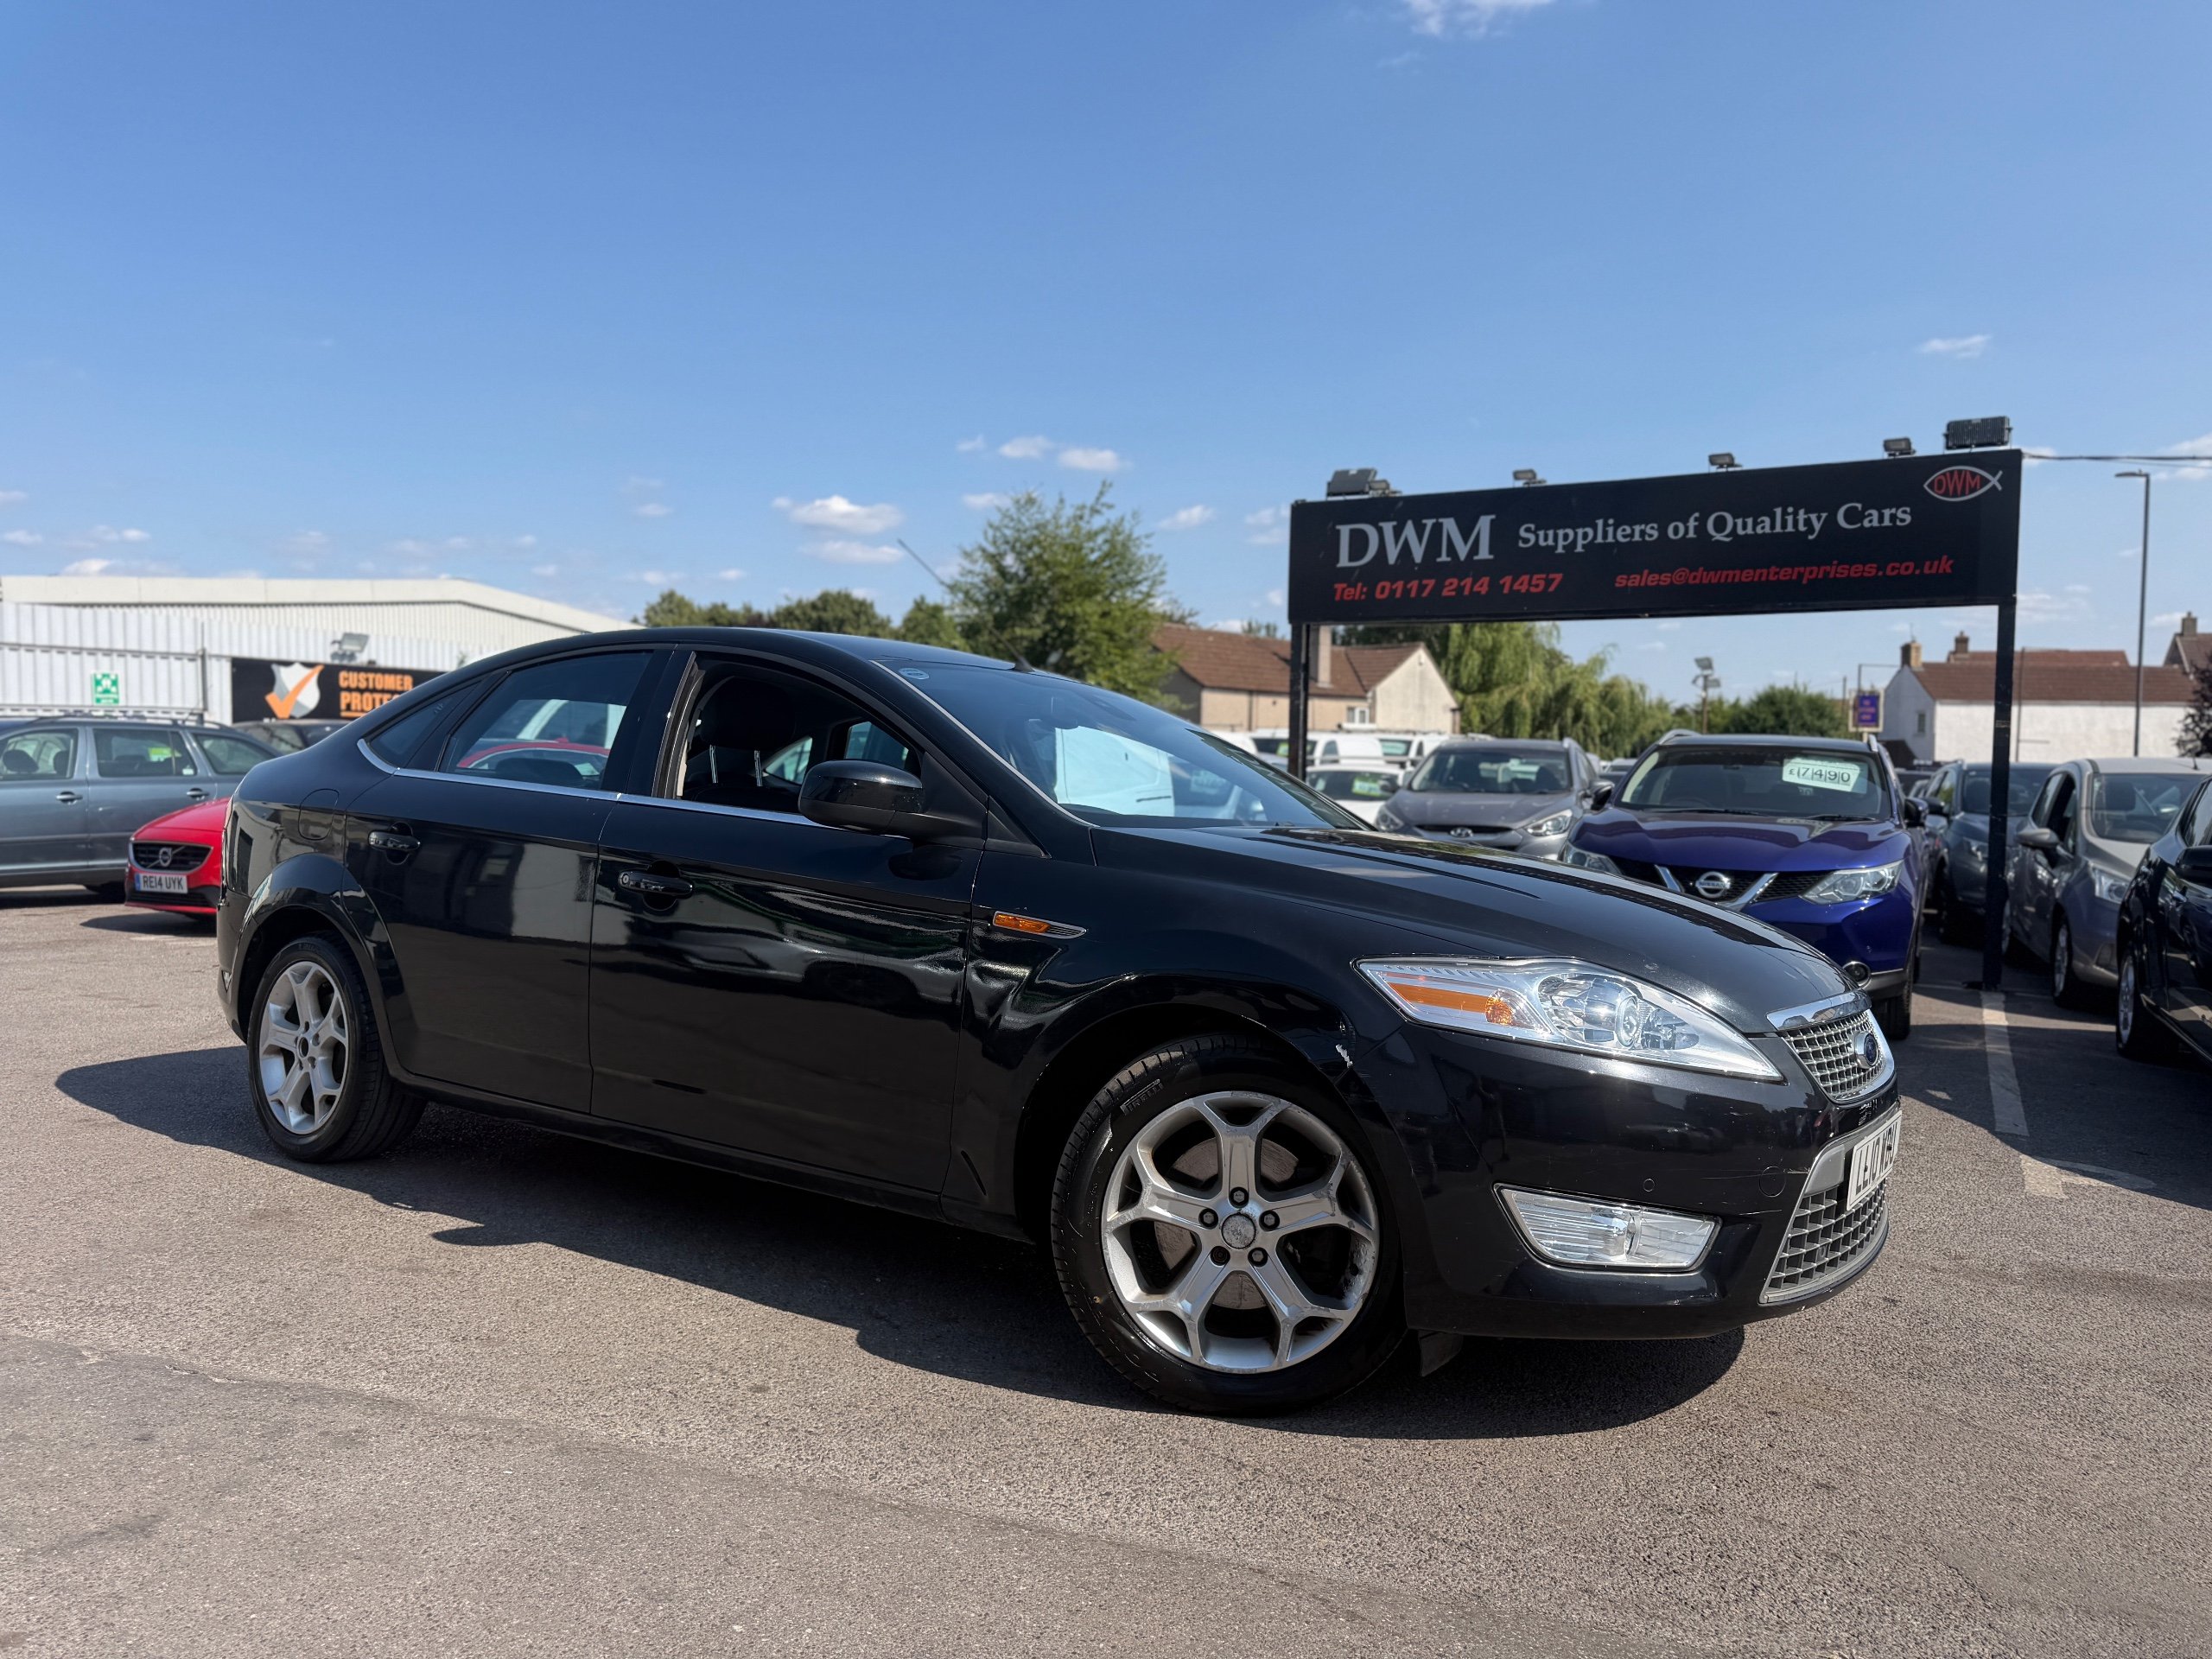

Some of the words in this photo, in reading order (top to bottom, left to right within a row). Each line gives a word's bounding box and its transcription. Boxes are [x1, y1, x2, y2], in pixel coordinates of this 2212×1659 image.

[1934, 469, 1980, 498] DWM
[1336, 515, 1496, 568] DWM
[1518, 518, 1659, 553] Suppliers
[1667, 512, 1700, 539] of
[1707, 506, 1828, 542] Quality
[1837, 503, 1912, 529] Cars
[1615, 555, 1954, 588] sales@dwmenterprises.co.uk
[1334, 582, 1368, 601] Tel:
[1375, 579, 1436, 599] 0117
[1441, 576, 1491, 597] 214
[1499, 573, 1563, 594] 1457
[339, 671, 413, 690] CUSTOMER
[143, 875, 162, 889] RE14
[165, 876, 183, 890] UYK
